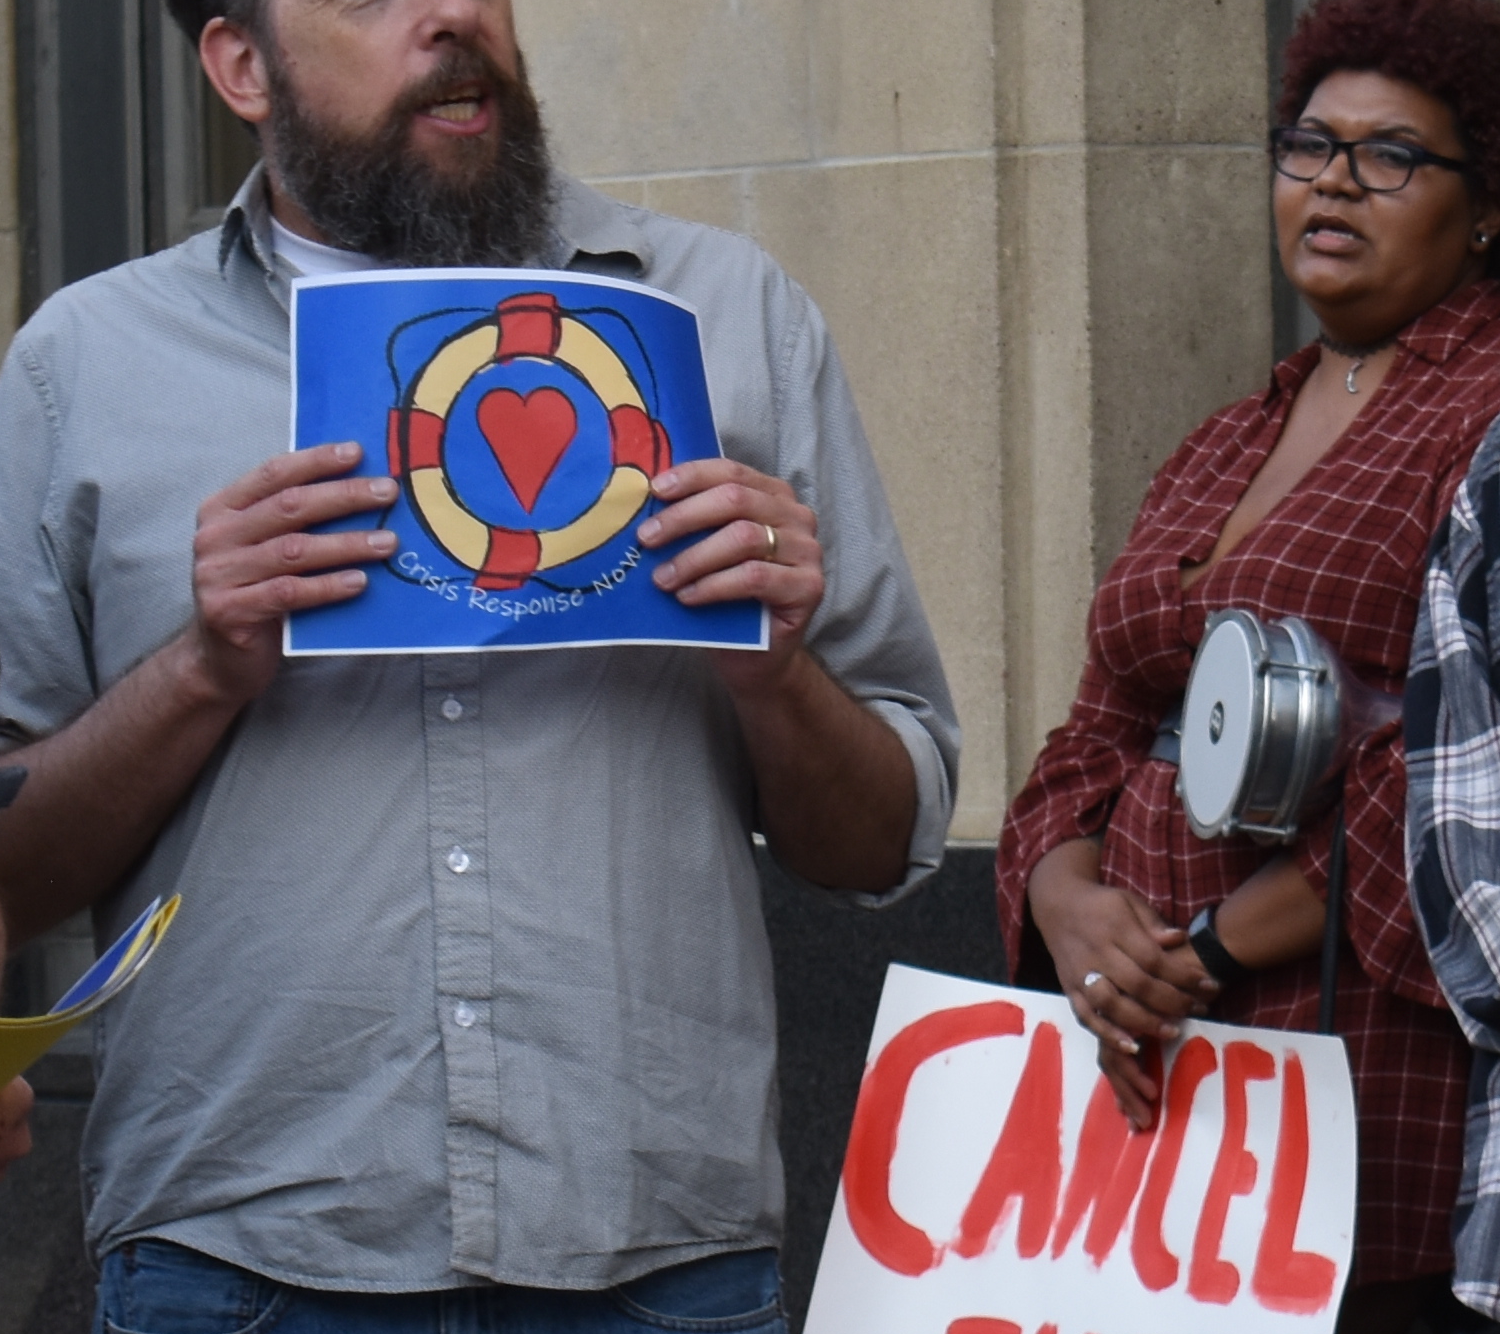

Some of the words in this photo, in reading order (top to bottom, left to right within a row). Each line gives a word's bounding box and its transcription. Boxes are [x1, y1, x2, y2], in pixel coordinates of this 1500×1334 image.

[397, 551, 459, 601] Crisis
[464, 585, 585, 622] Response
[841, 1000, 1337, 1315] CANCEL
